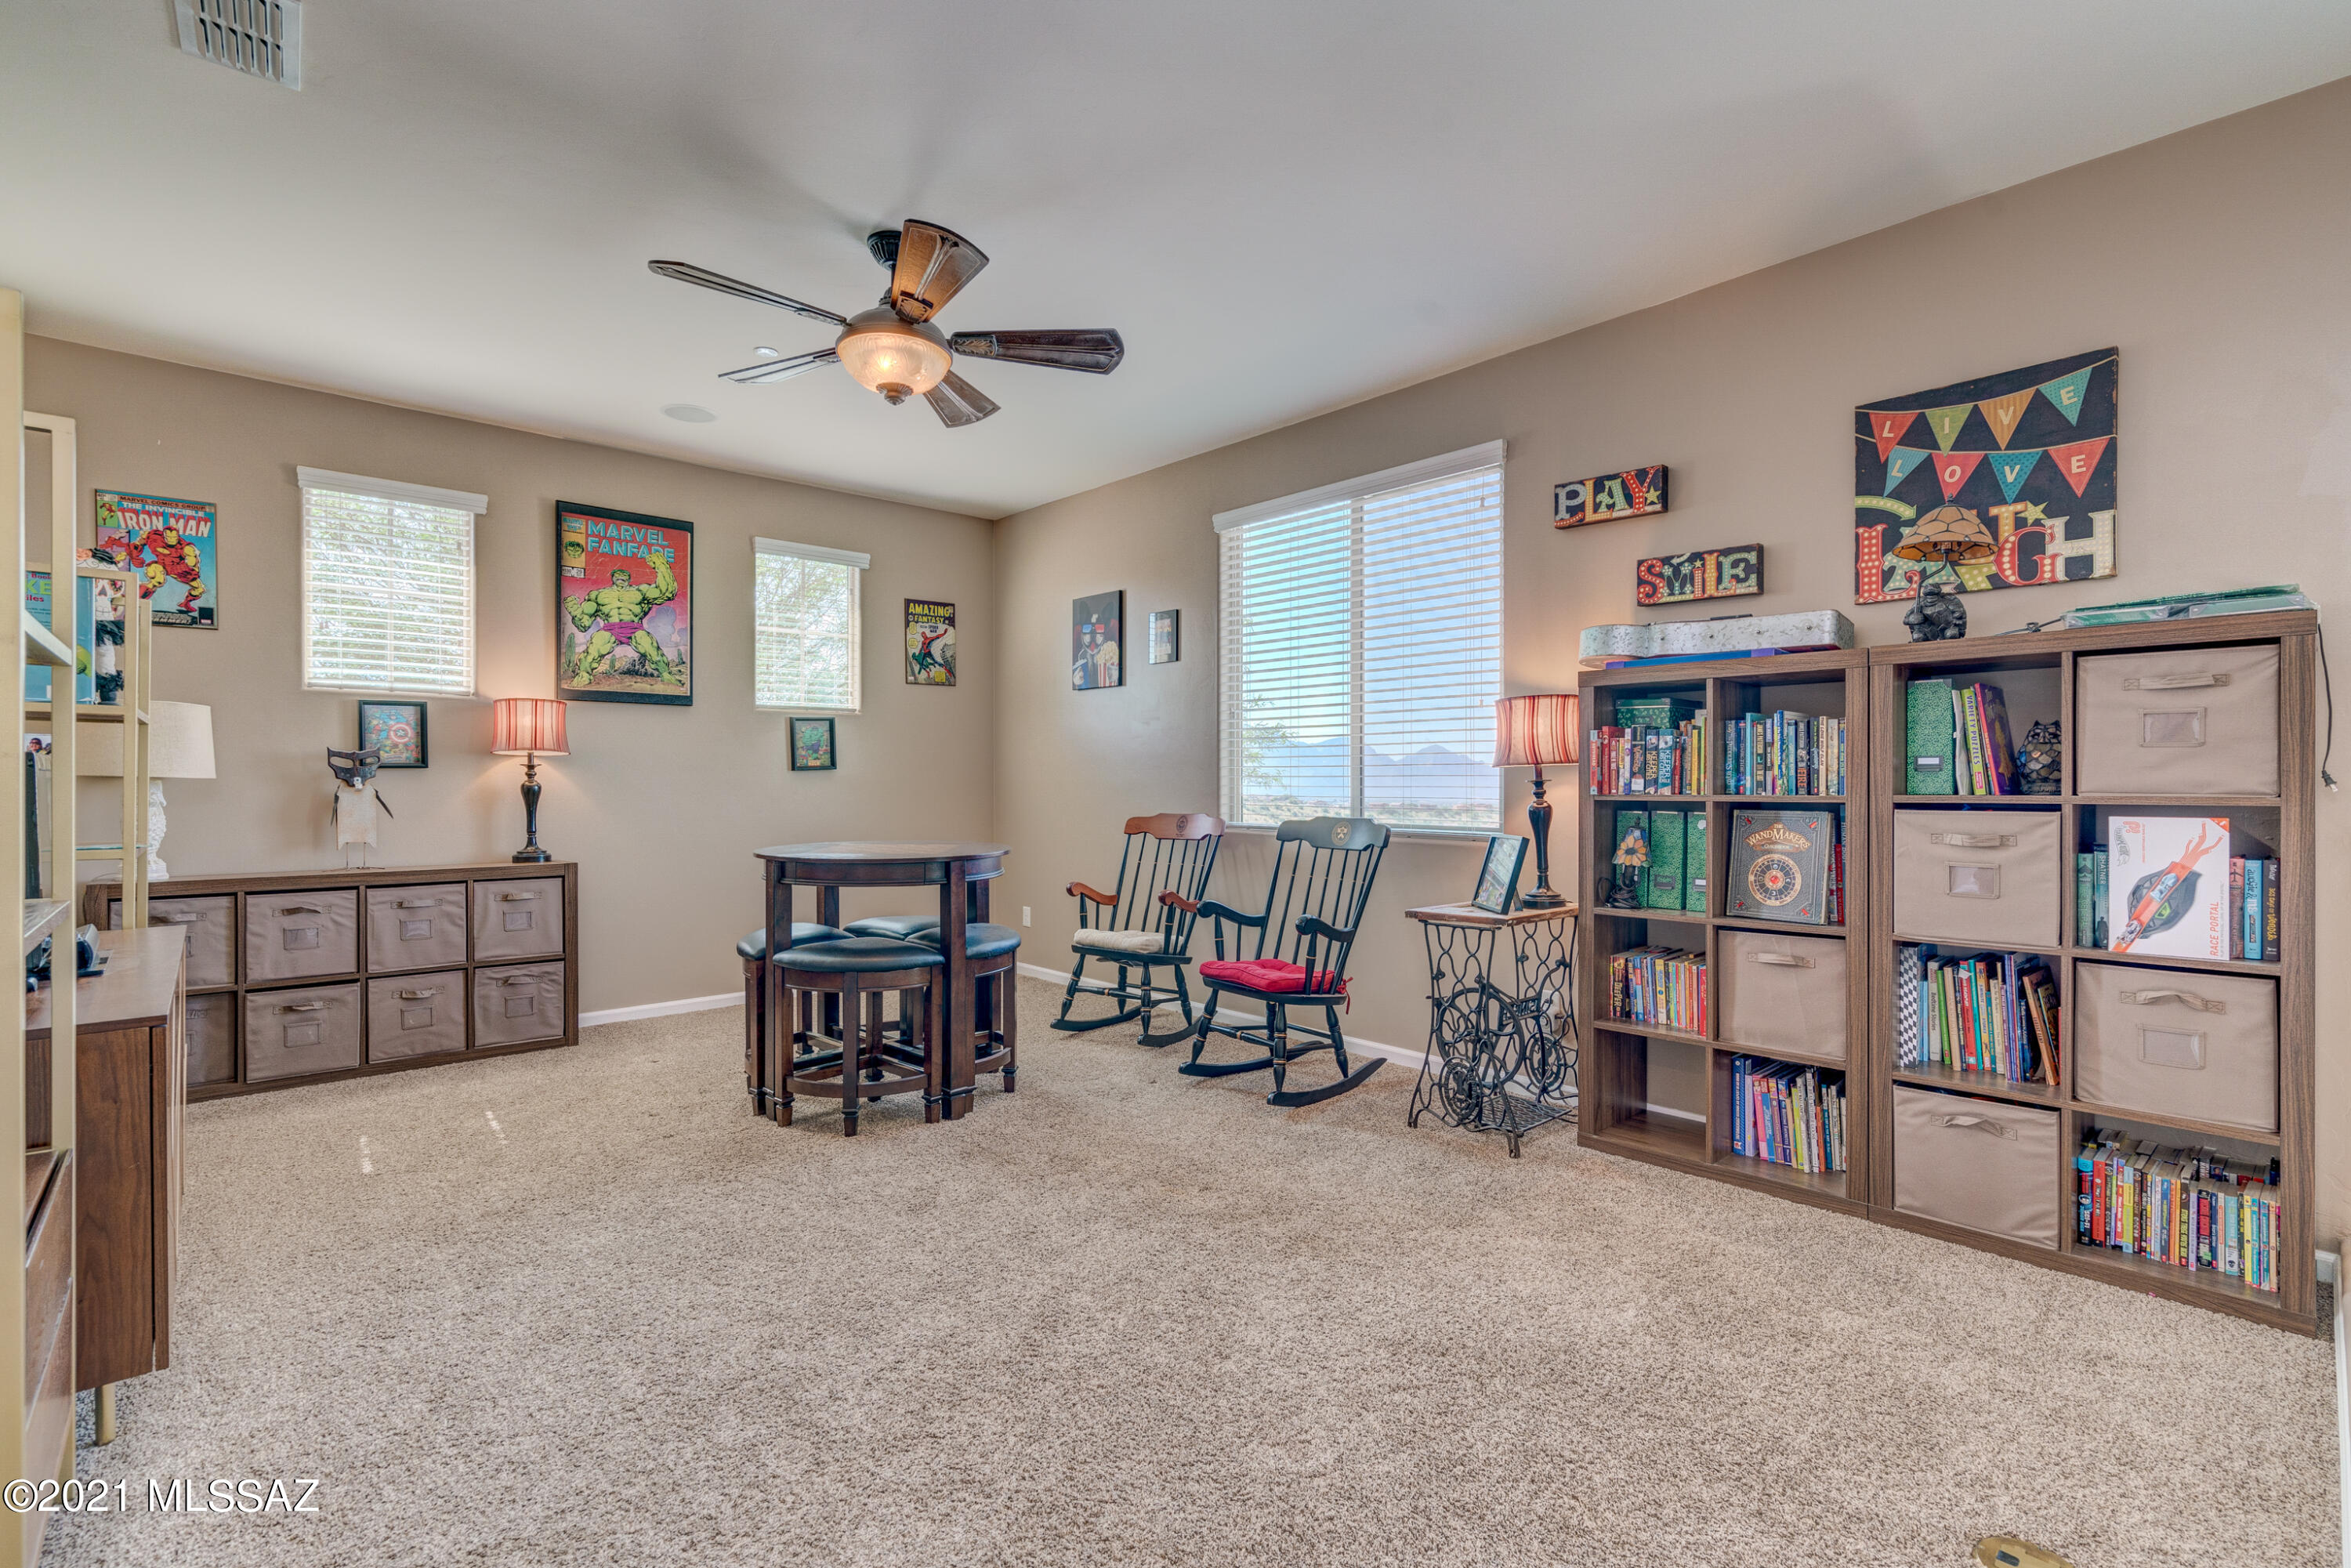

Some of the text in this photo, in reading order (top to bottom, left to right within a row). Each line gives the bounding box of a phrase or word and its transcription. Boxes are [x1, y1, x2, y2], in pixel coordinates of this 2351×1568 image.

[1891, 454, 2086, 483] LOVE
[1555, 465, 1661, 523] PLAY
[118, 508, 212, 538] IRON MAN
[145, 504, 205, 517] INVINCIBLE
[588, 520, 669, 546] MARVEL
[1637, 551, 1758, 604] SMILE
[909, 603, 950, 617] AMAZING
[915, 615, 944, 624] FANTASY
[1966, 695, 1976, 728] VARIETY
[1970, 730, 1981, 766] PUZZLES
[2209, 901, 2219, 957] RACE PORTAL
[1614, 982, 1623, 1007] DEEPER
